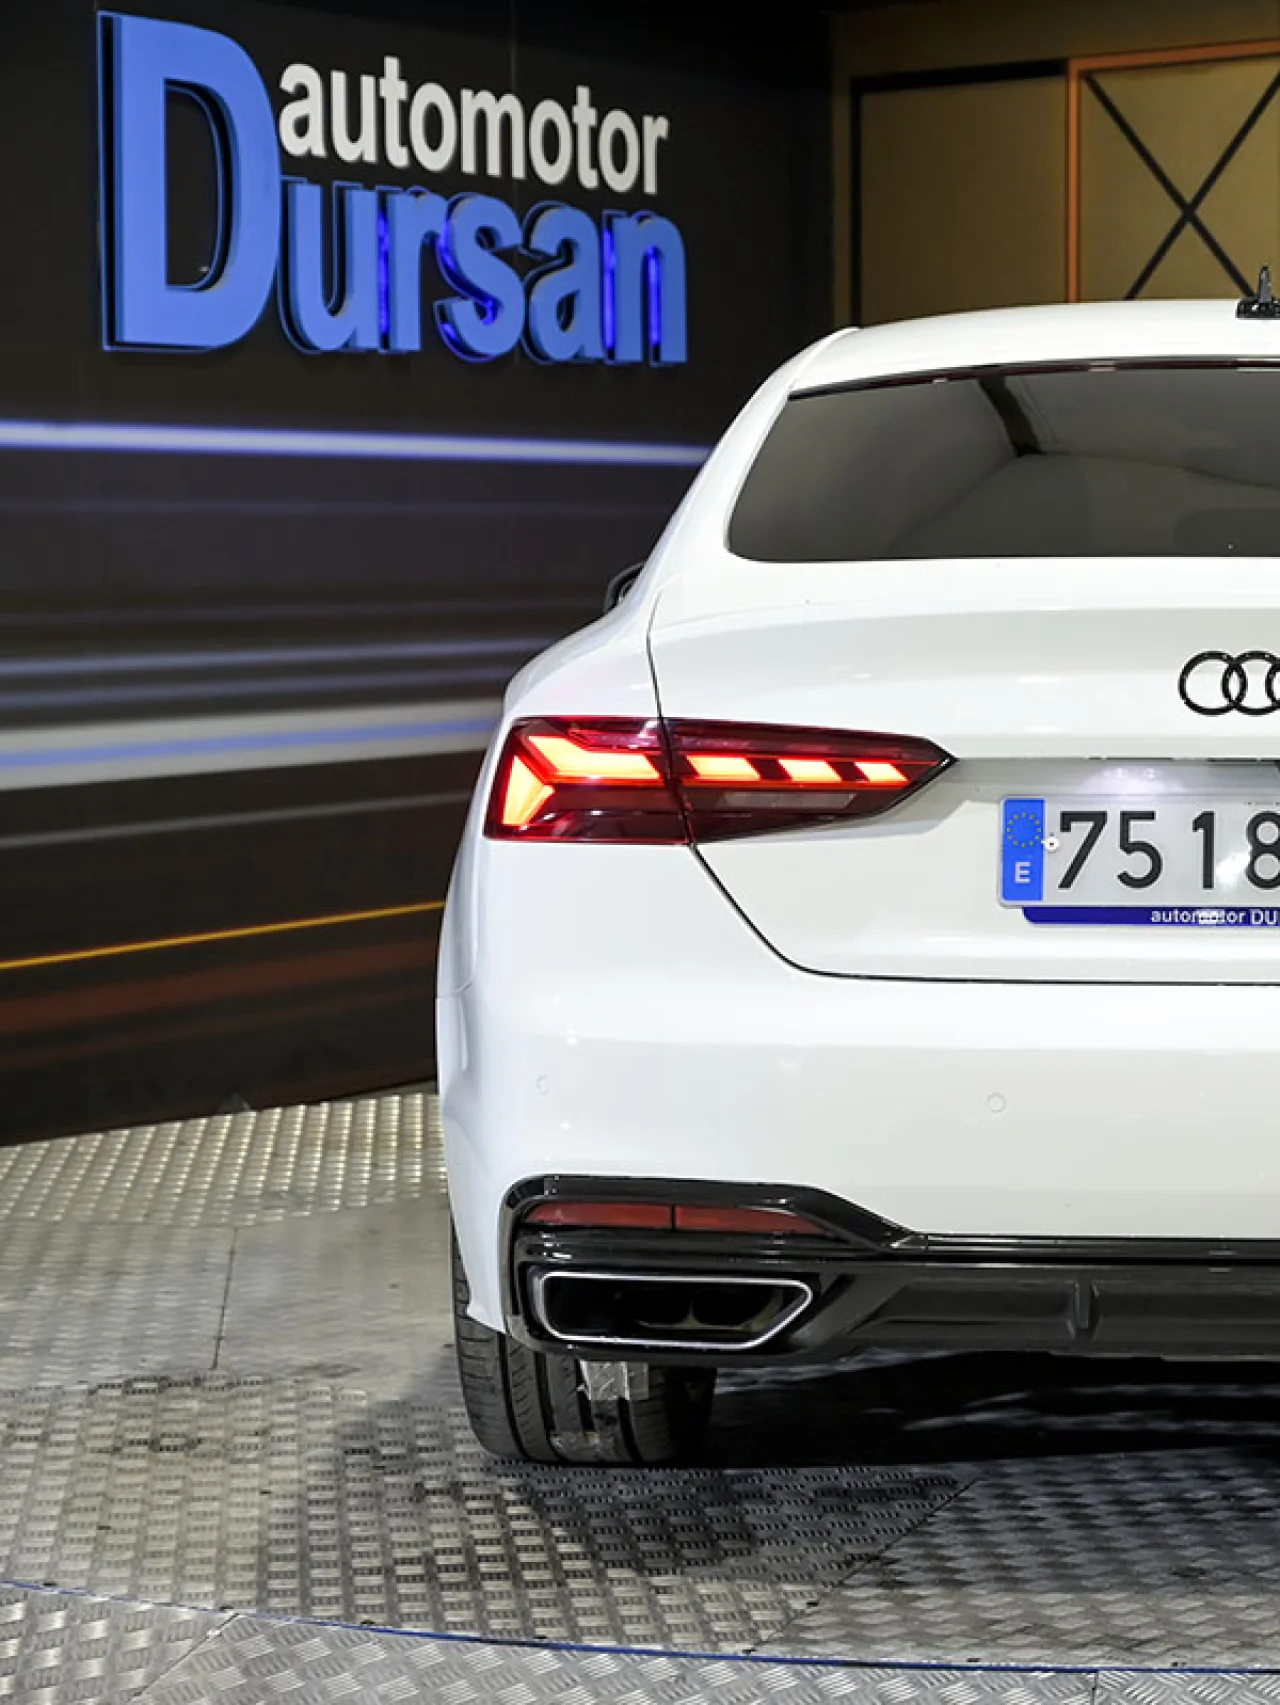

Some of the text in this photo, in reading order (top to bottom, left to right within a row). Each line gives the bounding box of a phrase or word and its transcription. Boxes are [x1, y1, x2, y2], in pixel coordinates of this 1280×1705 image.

[98, 10, 688, 365] Dursan
[278, 56, 670, 195] automotor
[1013, 861, 1032, 884] E
